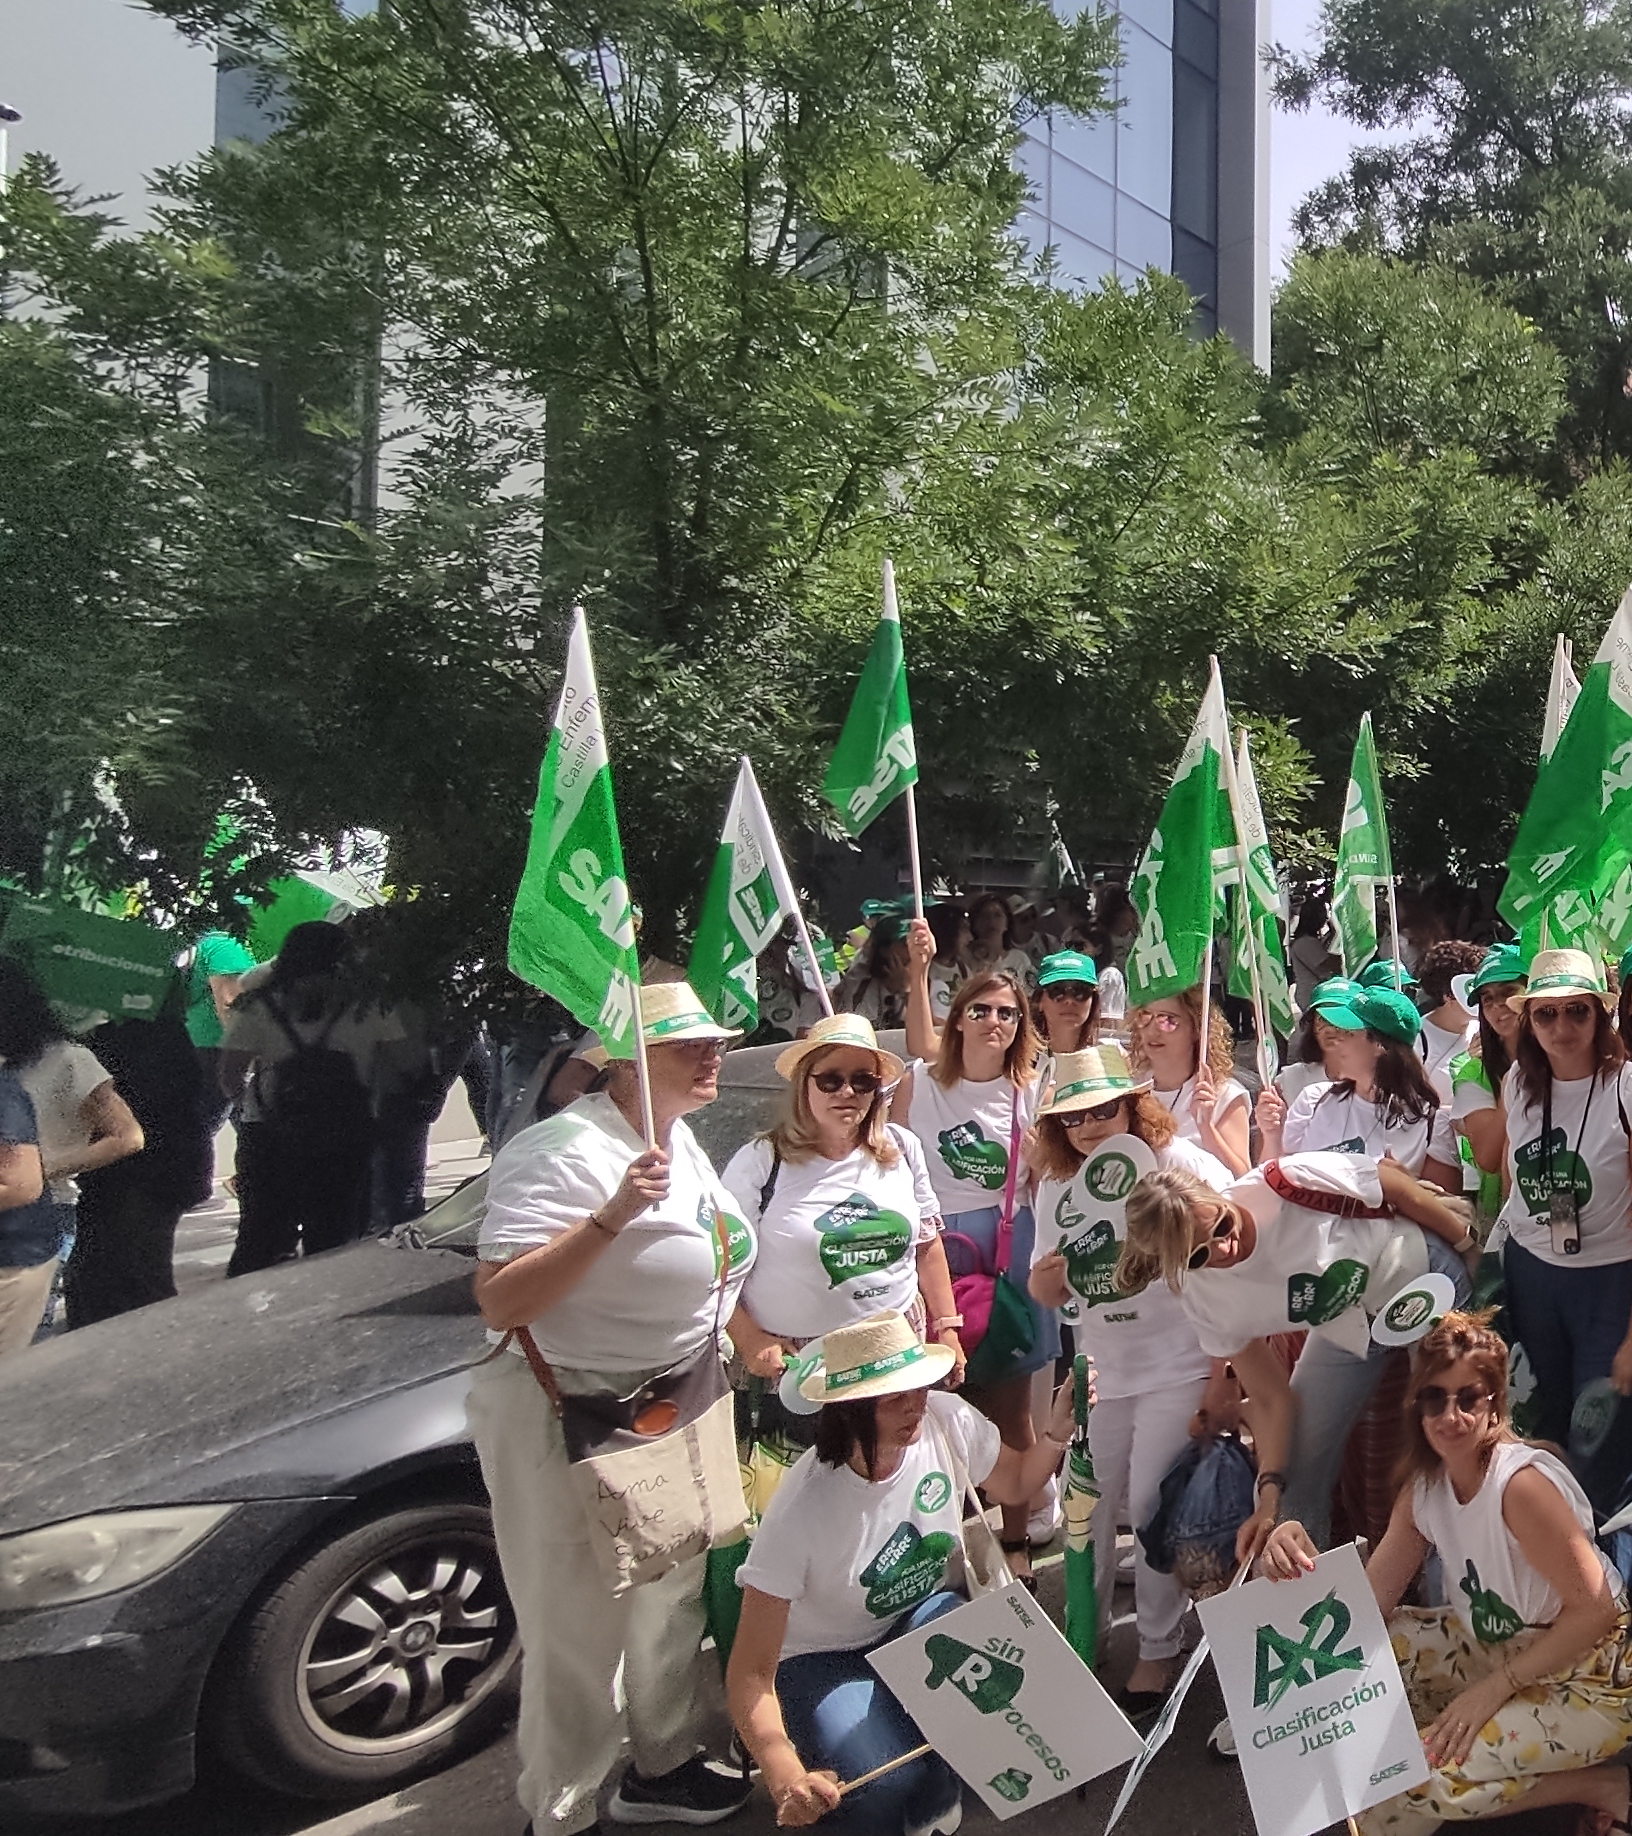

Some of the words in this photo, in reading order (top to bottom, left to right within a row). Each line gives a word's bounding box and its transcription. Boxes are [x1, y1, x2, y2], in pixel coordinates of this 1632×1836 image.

[52, 944, 164, 977] etribuciones
[835, 1248, 888, 1268] JUSTA
[852, 1284, 891, 1301] SATSE
[875, 1539, 898, 1572] ERRE
[888, 1533, 913, 1566] ERRE
[885, 1574, 936, 1608] JUSTA
[1006, 1595, 1035, 1630] SATSE
[1482, 1614, 1515, 1635] JUS
[983, 1637, 1026, 1664] sin
[1252, 1679, 1388, 1750] Clasificación
[1298, 1718, 1357, 1757] Justa
[1369, 1759, 1411, 1787] SATSE
